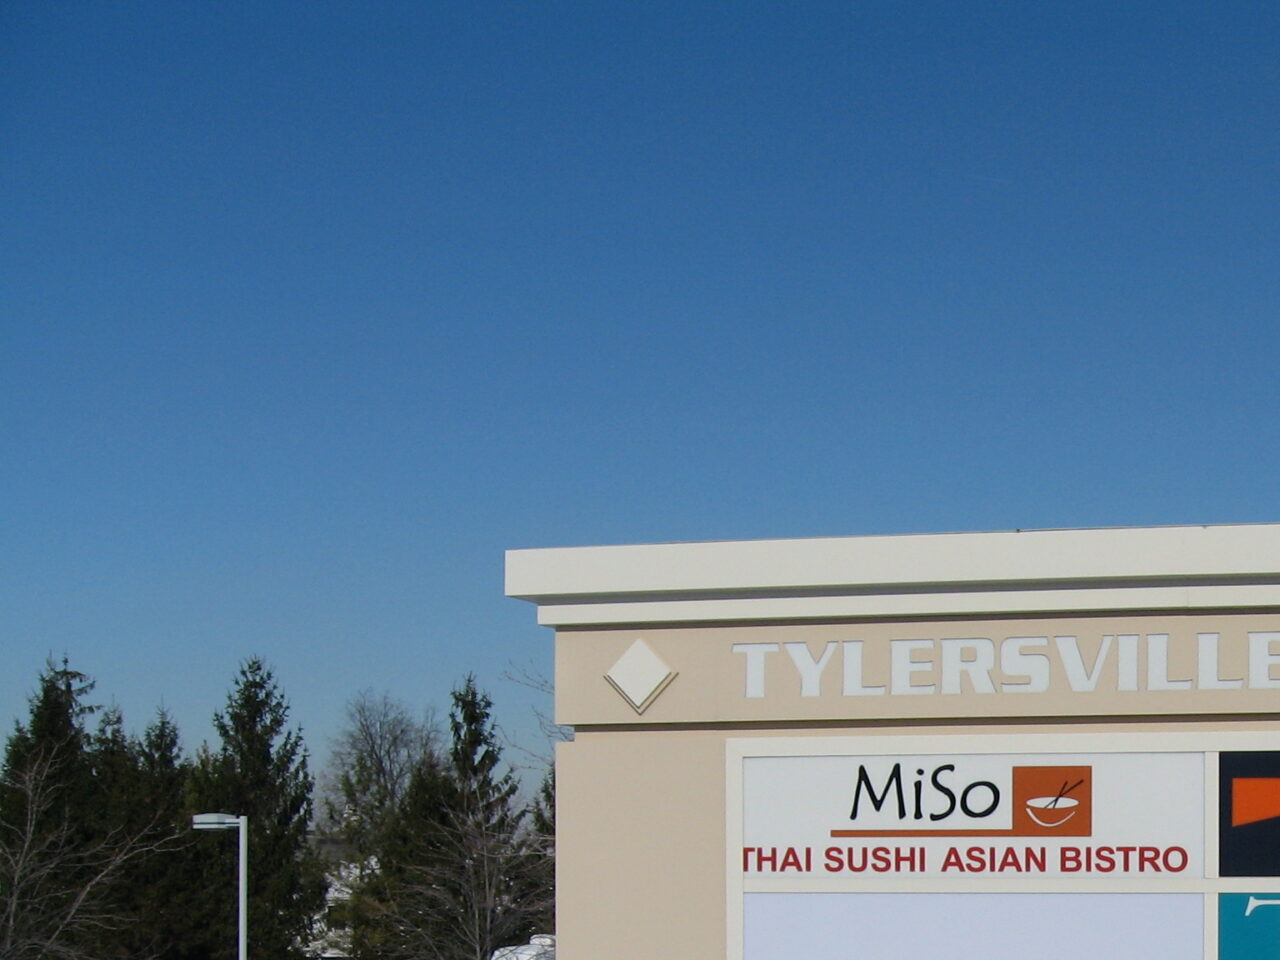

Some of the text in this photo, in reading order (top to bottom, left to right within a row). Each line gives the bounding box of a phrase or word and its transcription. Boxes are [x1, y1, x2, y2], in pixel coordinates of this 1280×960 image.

[850, 763, 1001, 822] MiSo
[824, 846, 925, 873] SUSHI
[940, 846, 1046, 873] ASIAN
[1059, 846, 1189, 873] BISTRO
